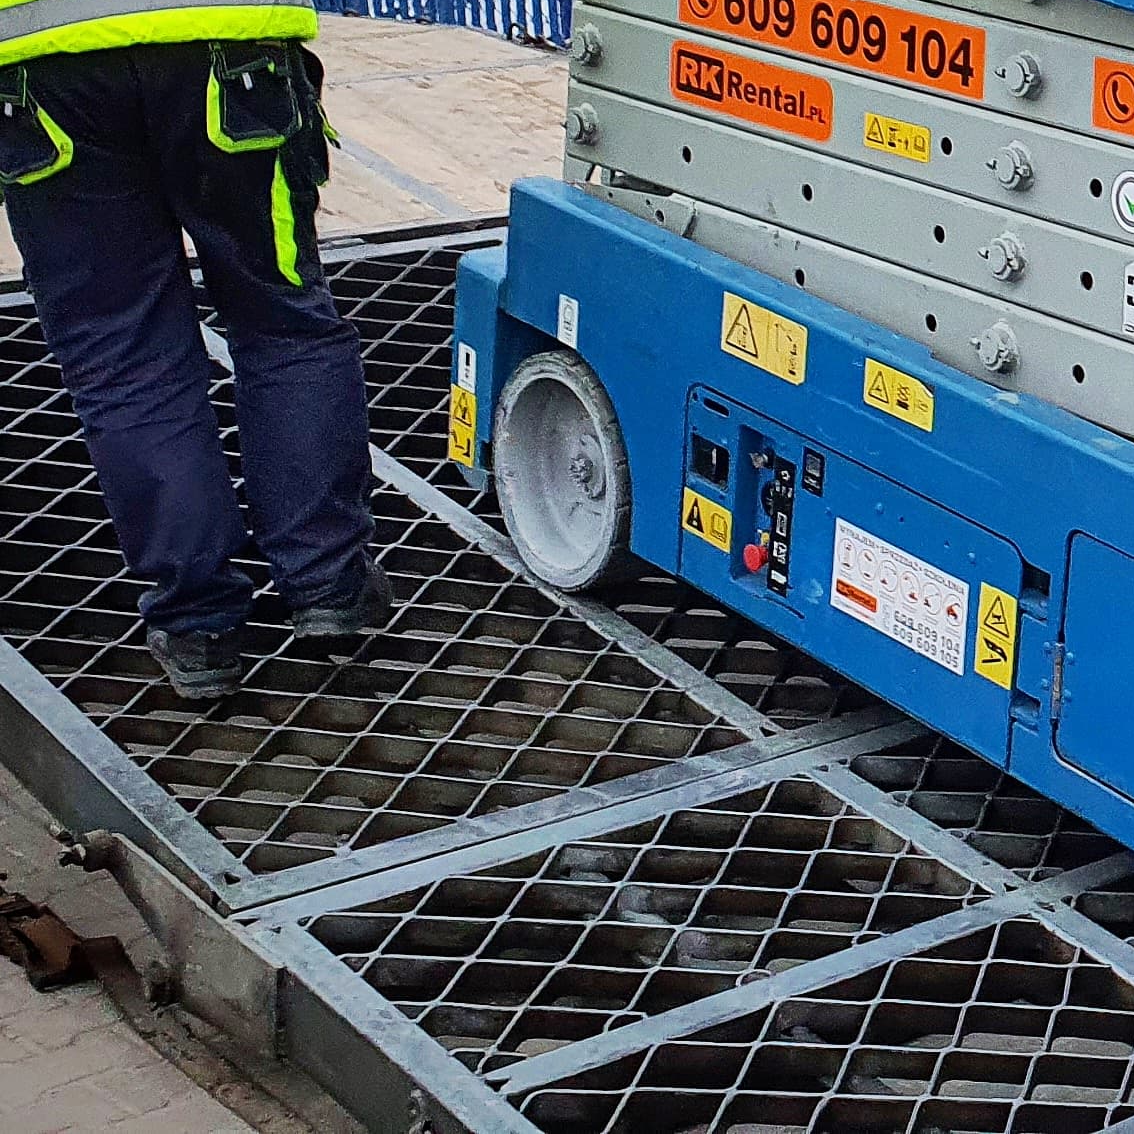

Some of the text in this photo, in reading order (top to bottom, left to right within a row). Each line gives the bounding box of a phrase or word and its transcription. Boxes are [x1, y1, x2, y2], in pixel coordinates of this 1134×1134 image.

[678, 52, 724, 101] RK
[810, 2, 887, 63] 609
[900, 25, 975, 87] 104
